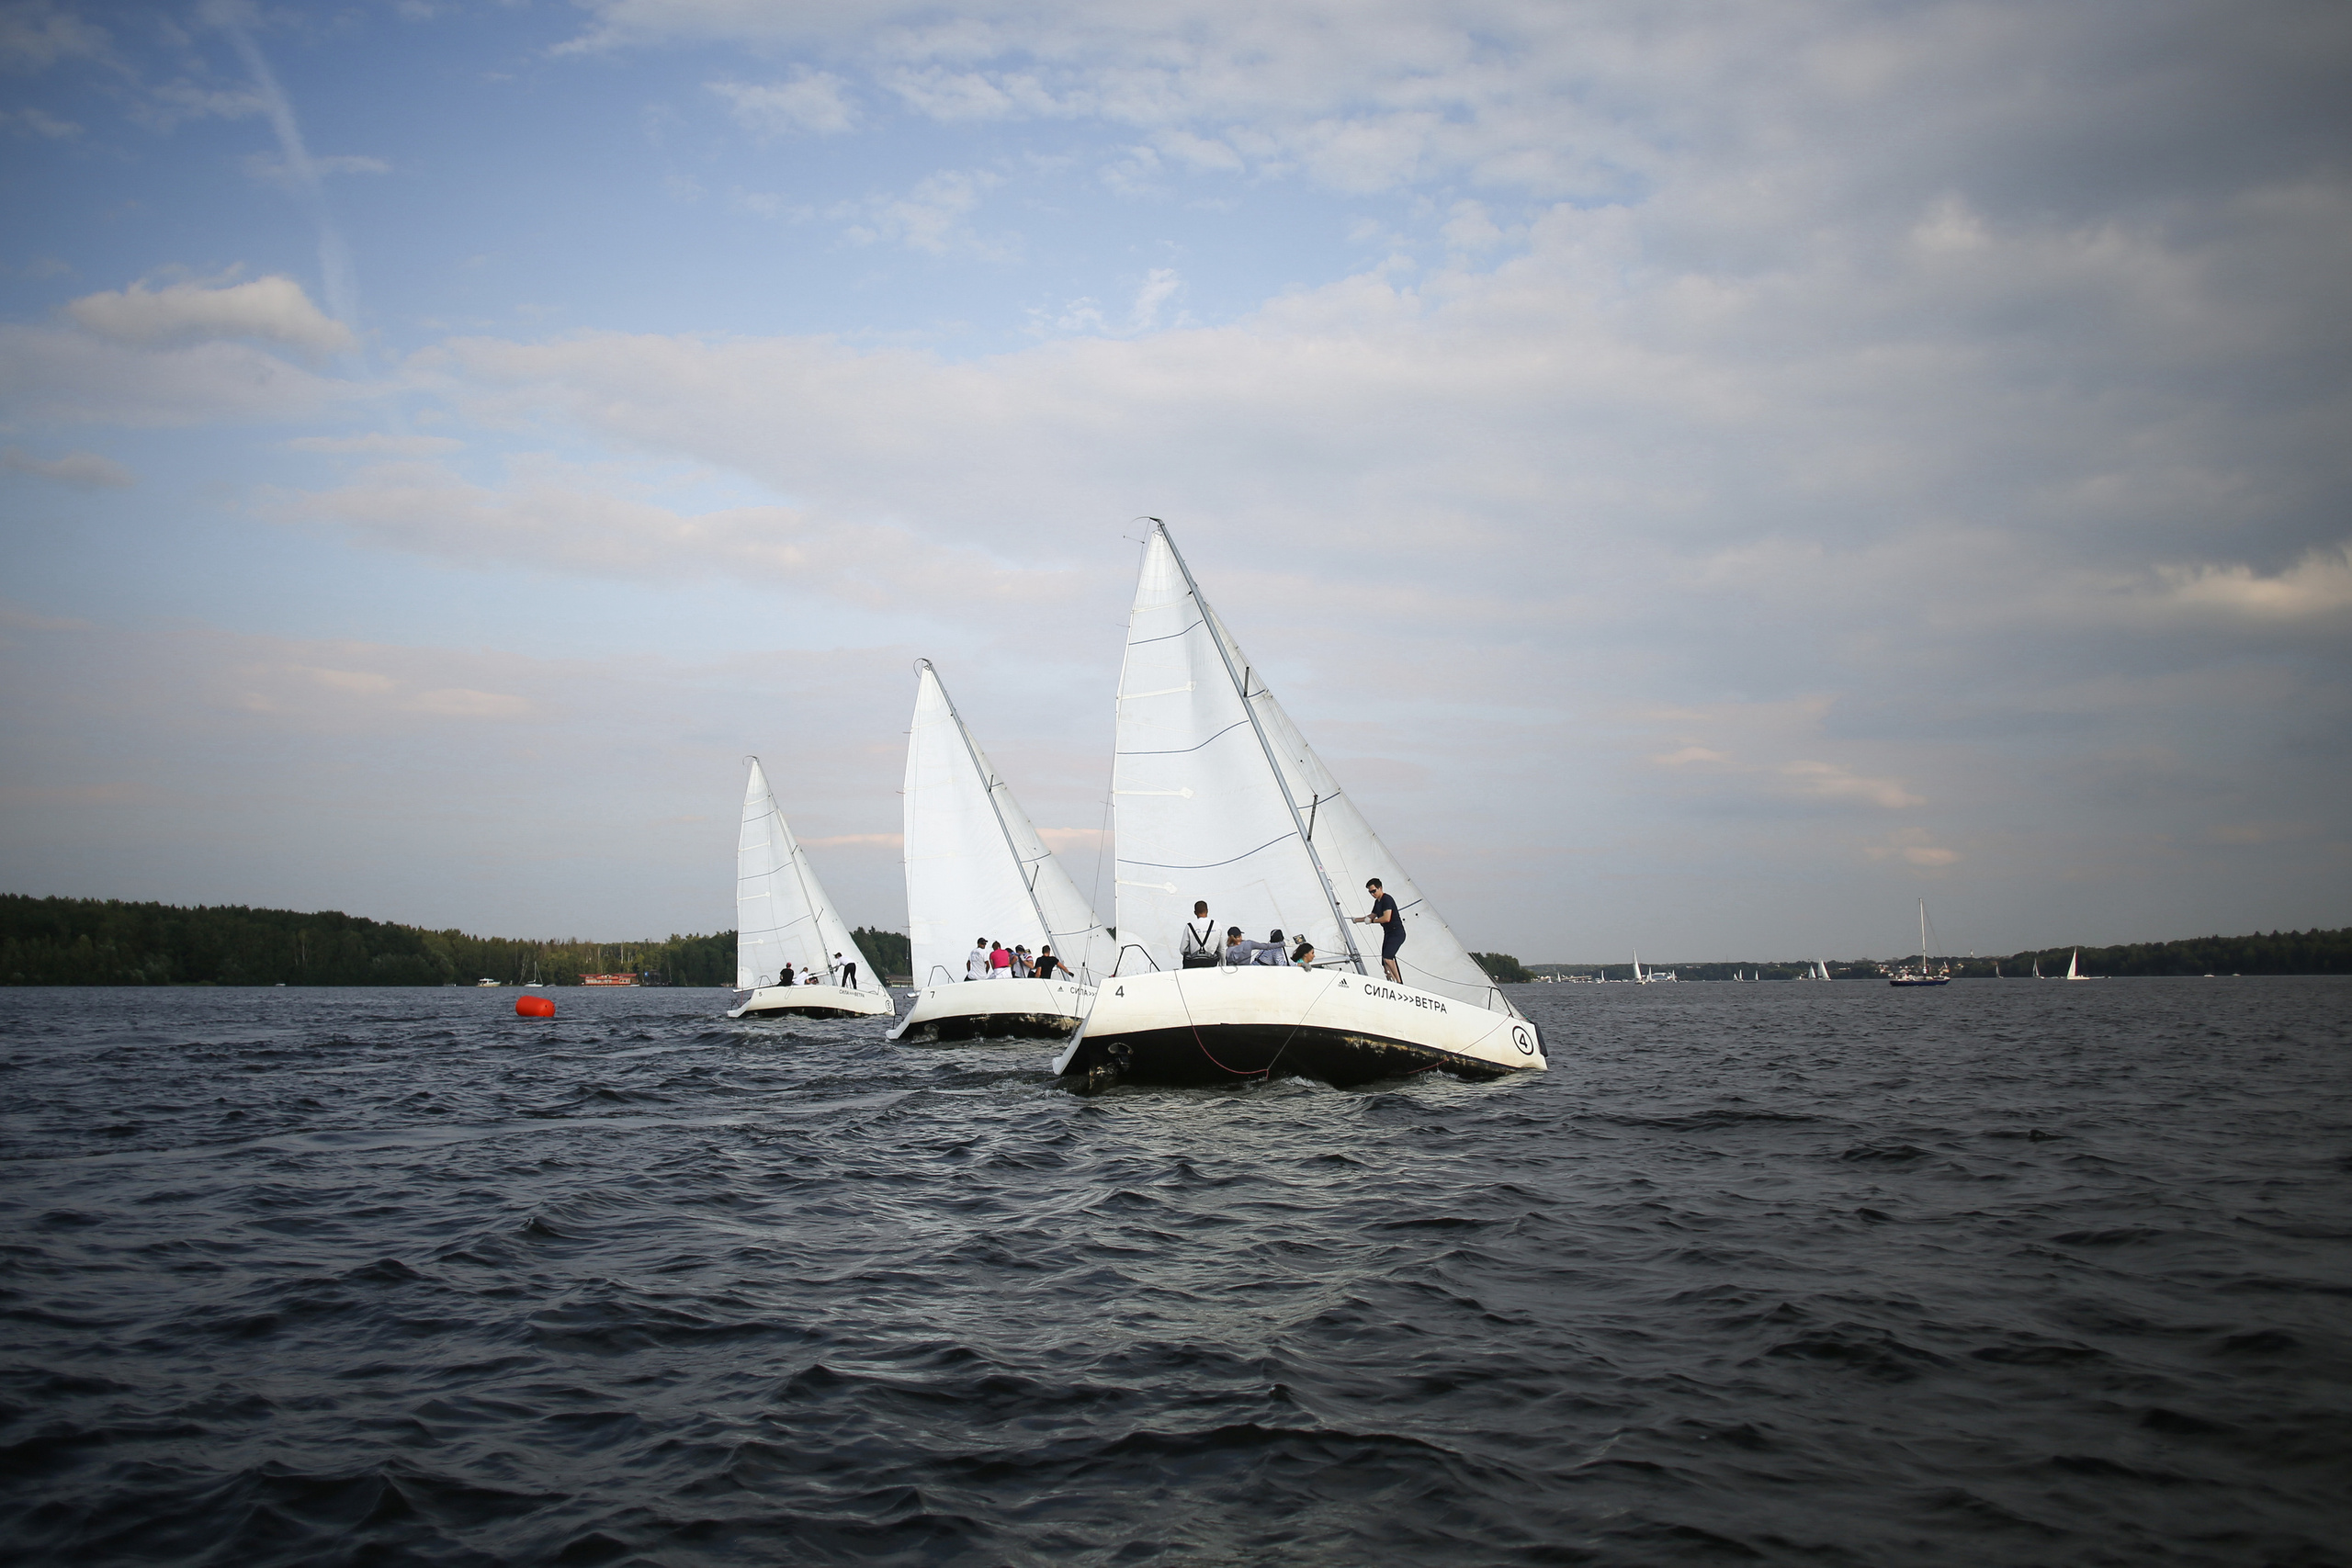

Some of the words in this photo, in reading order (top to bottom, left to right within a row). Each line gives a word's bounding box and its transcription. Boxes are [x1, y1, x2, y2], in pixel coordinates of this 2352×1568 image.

[930, 990, 935, 998] 7
[1114, 985, 1125, 998] 4
[1519, 1033, 1528, 1048] 4
